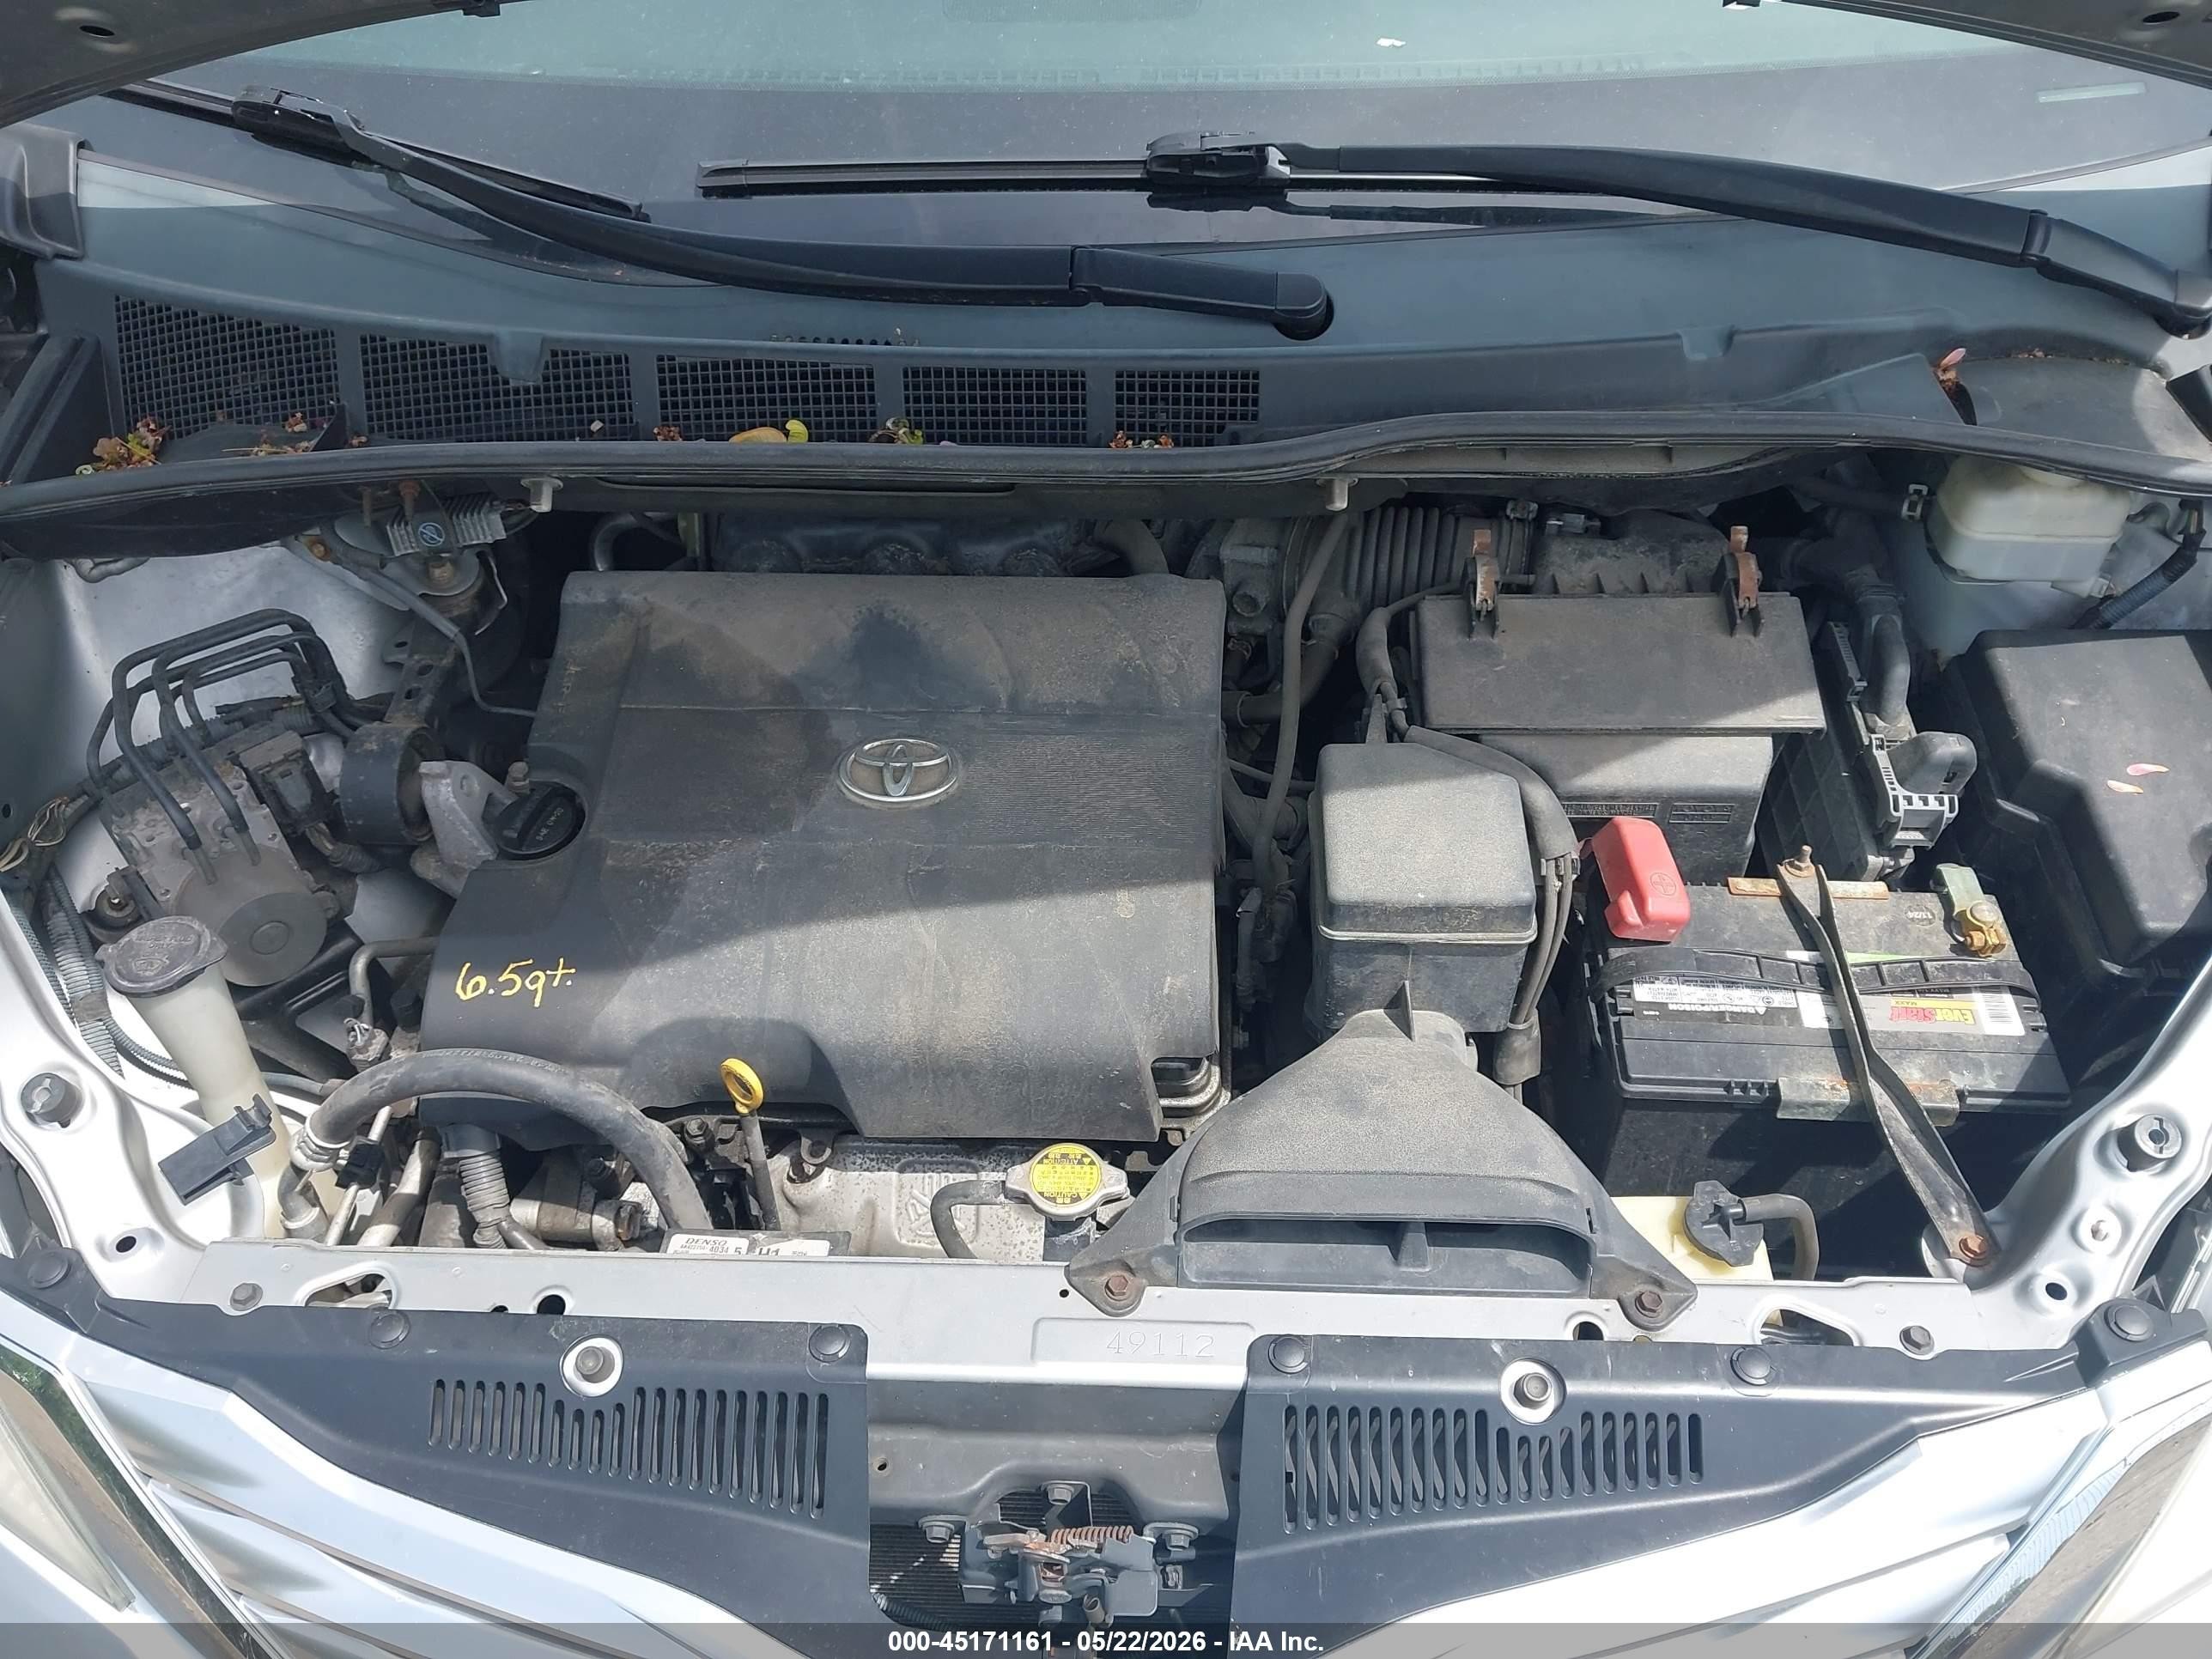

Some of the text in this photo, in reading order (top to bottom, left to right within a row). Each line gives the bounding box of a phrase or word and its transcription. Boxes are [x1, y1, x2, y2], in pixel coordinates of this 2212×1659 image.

[1890, 1006, 1975, 1025] EverStart
[686, 1237, 728, 1246] DENSO
[1106, 1330, 1216, 1358] 49112
